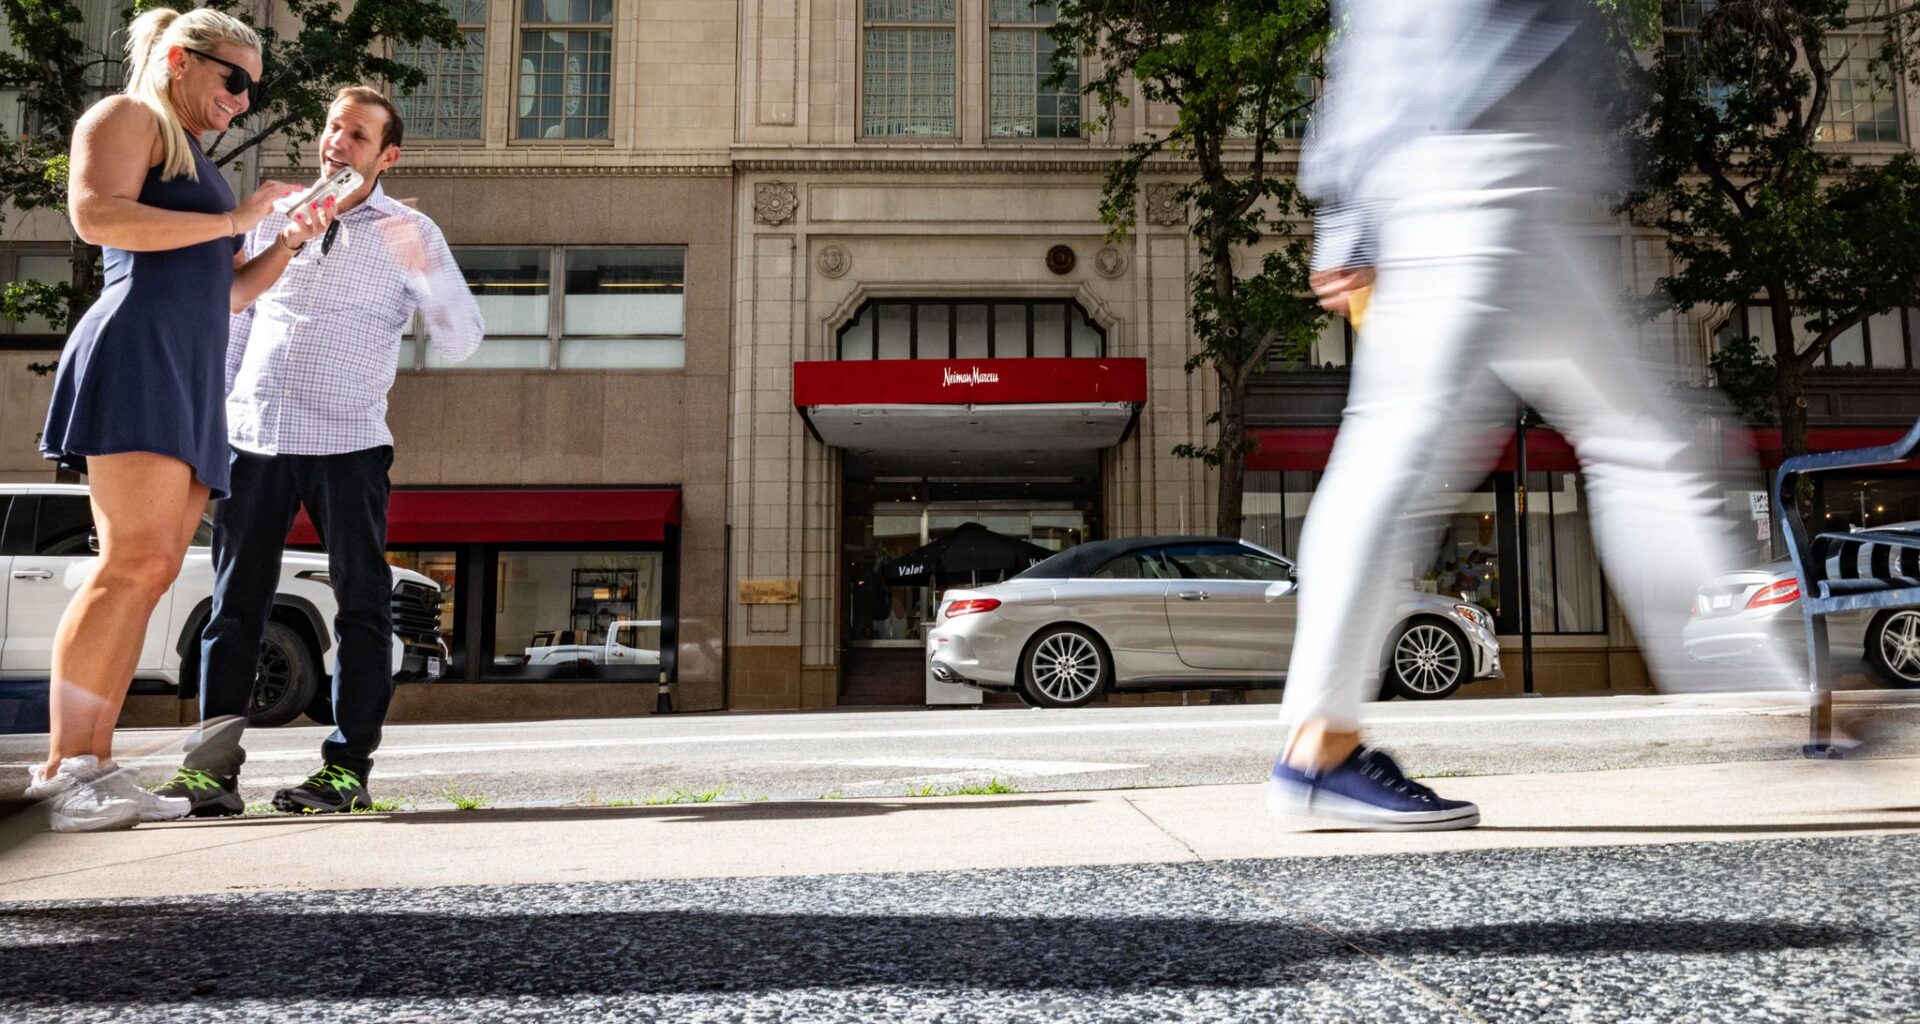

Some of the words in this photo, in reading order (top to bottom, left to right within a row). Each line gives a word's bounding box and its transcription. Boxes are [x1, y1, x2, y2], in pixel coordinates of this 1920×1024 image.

[942, 366, 971, 387] Neiman
[970, 365, 999, 387] Marcus
[898, 564, 924, 577] Valet
